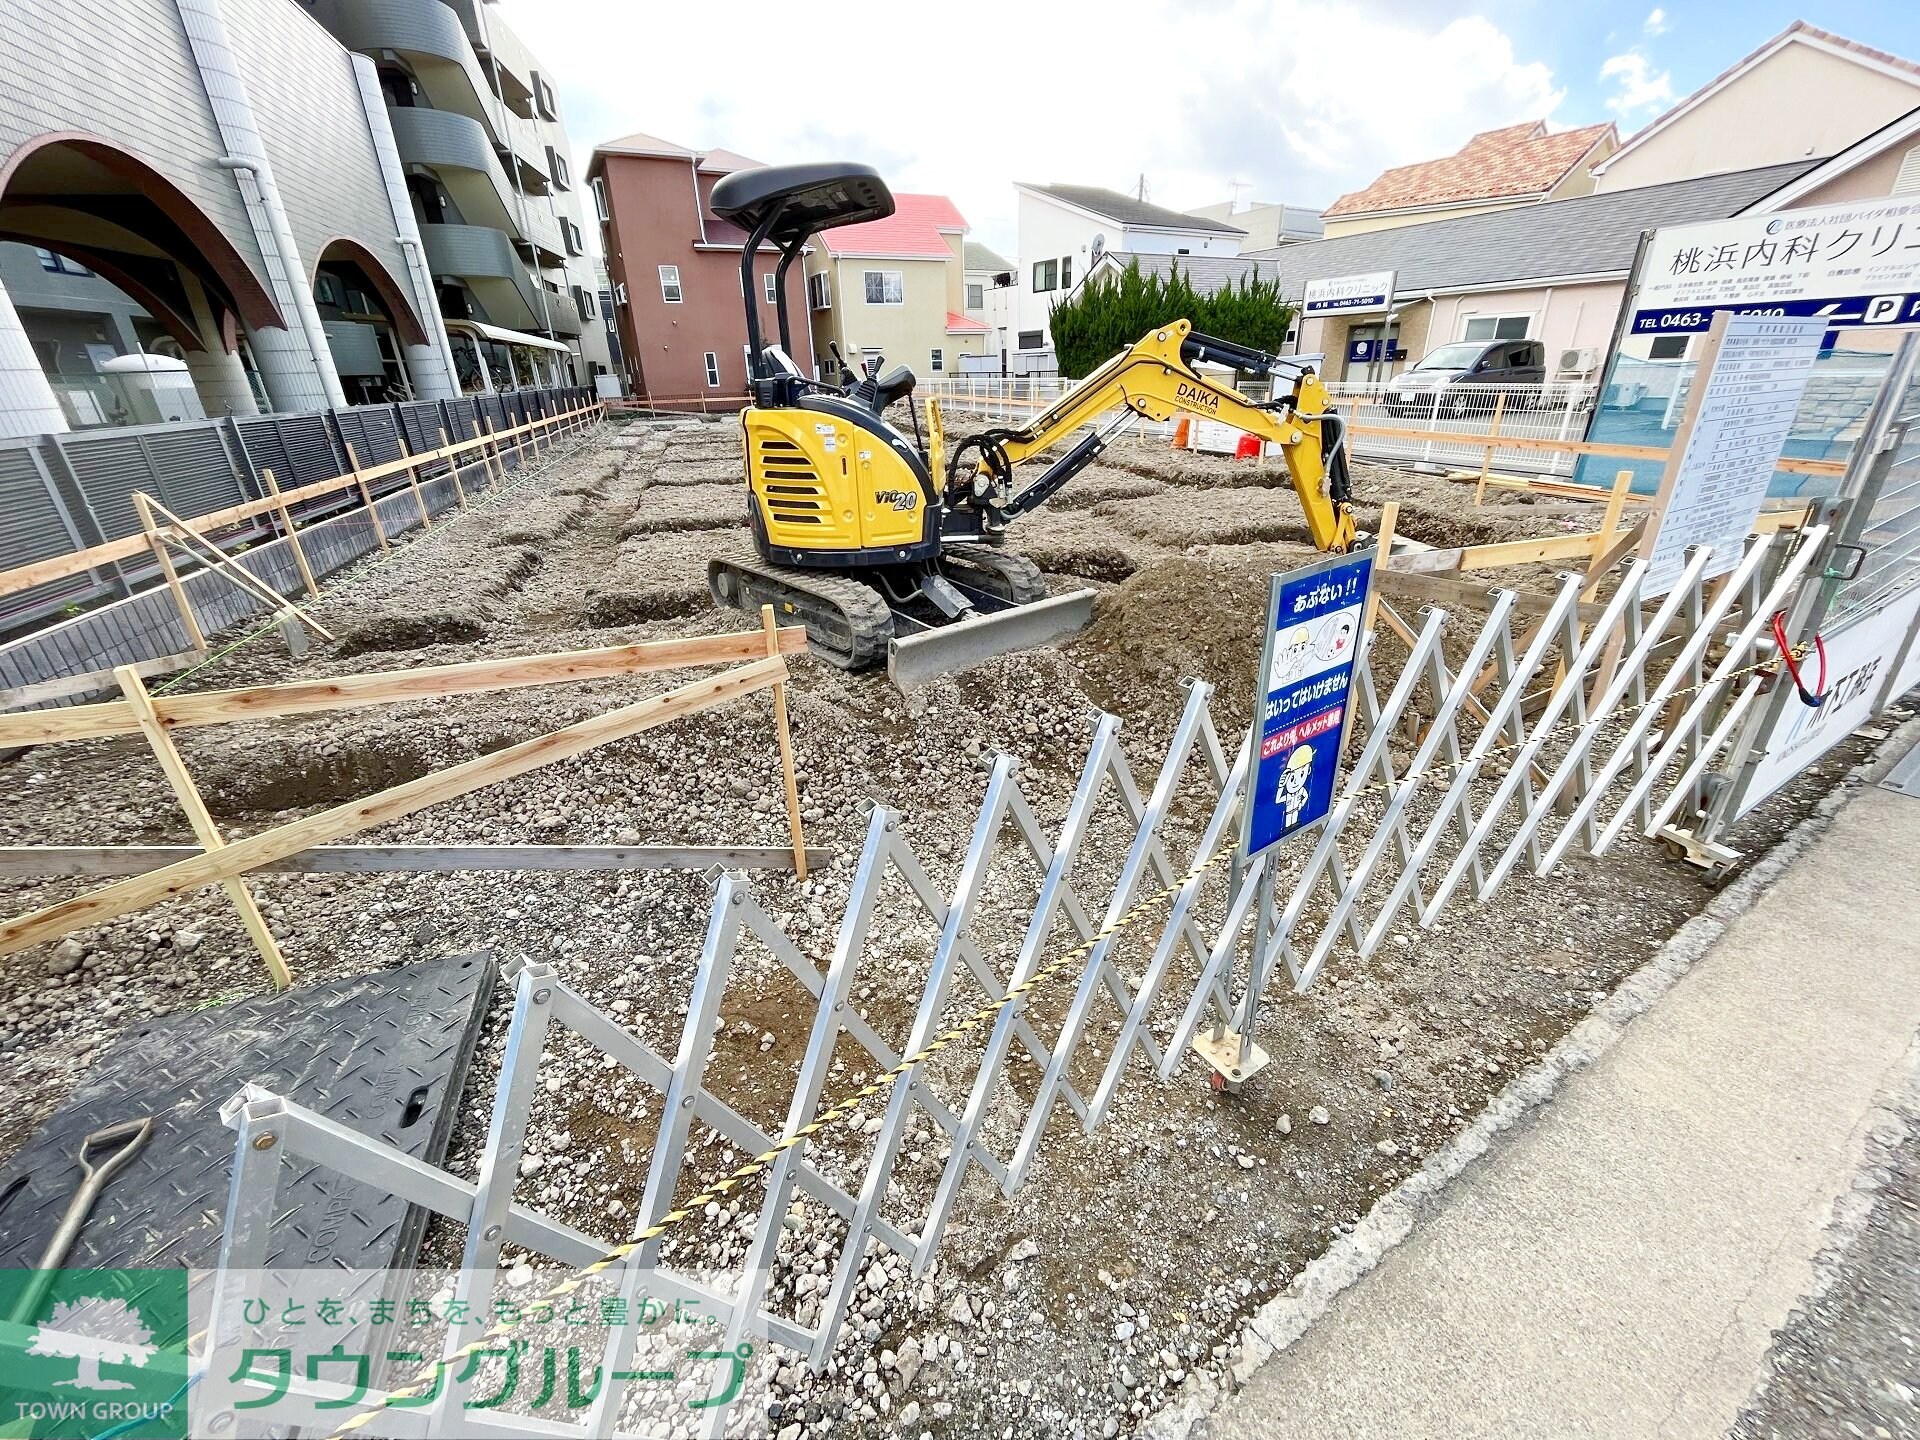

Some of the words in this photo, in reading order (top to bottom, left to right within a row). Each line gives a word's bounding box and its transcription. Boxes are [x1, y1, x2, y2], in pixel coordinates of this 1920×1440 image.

[1872, 300, 1895, 319] P
[1639, 318, 1658, 329] TEL
[1177, 383, 1219, 408] DAIKA
[1174, 396, 1217, 415] CONSTRUCTION
[1264, 671, 1349, 721] はいってはいけません
